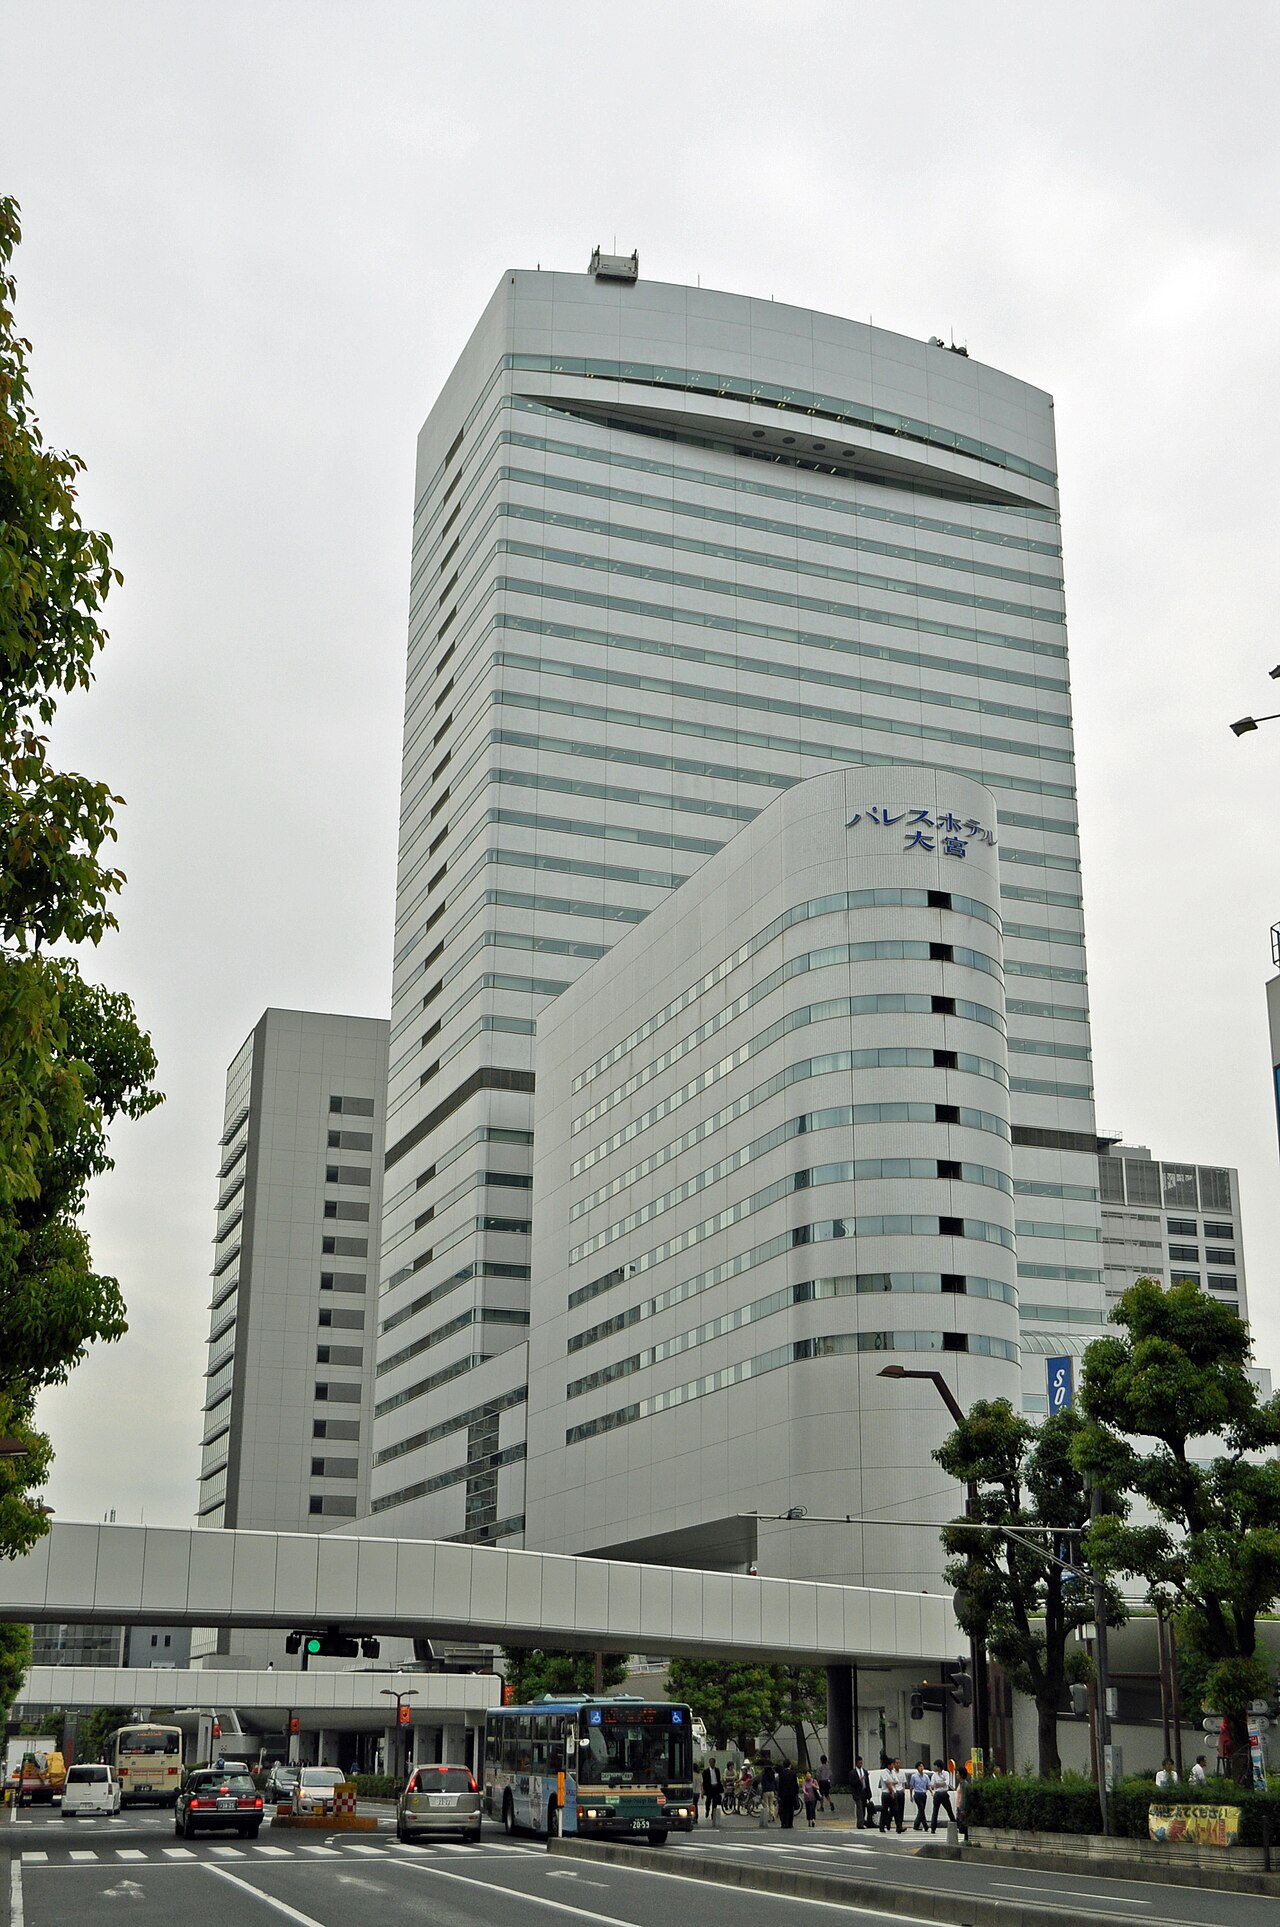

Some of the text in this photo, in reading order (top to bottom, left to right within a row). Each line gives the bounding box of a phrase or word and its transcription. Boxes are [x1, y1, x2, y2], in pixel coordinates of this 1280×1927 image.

[845, 806, 998, 847] パレスホテル
[903, 830, 968, 858] 大宮
